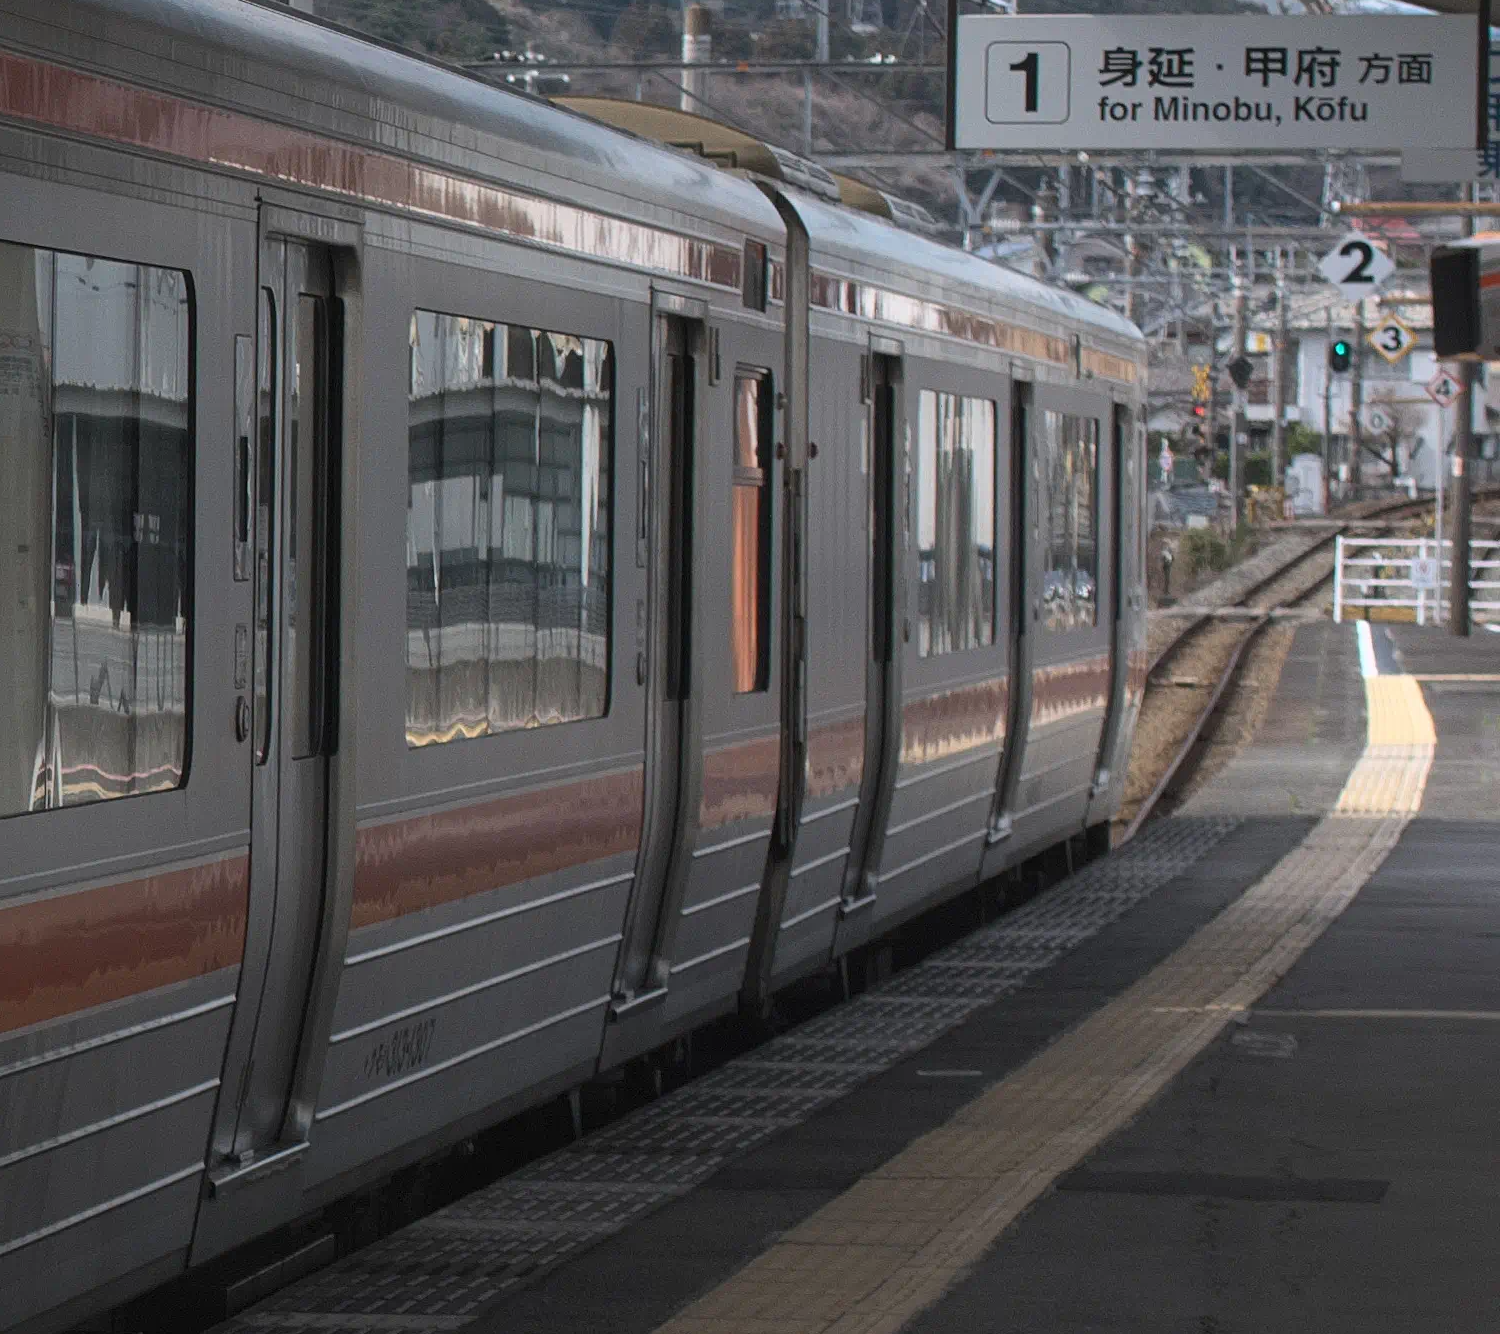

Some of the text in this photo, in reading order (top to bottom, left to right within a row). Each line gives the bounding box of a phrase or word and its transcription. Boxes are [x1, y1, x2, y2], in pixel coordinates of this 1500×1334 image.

[1008, 52, 1039, 112] 1
[1098, 46, 1434, 88] 身延・甲府 方面
[1098, 95, 1368, 126] for Minobu, Kōfu
[1339, 241, 1375, 283] 2
[1381, 327, 1401, 351] 3
